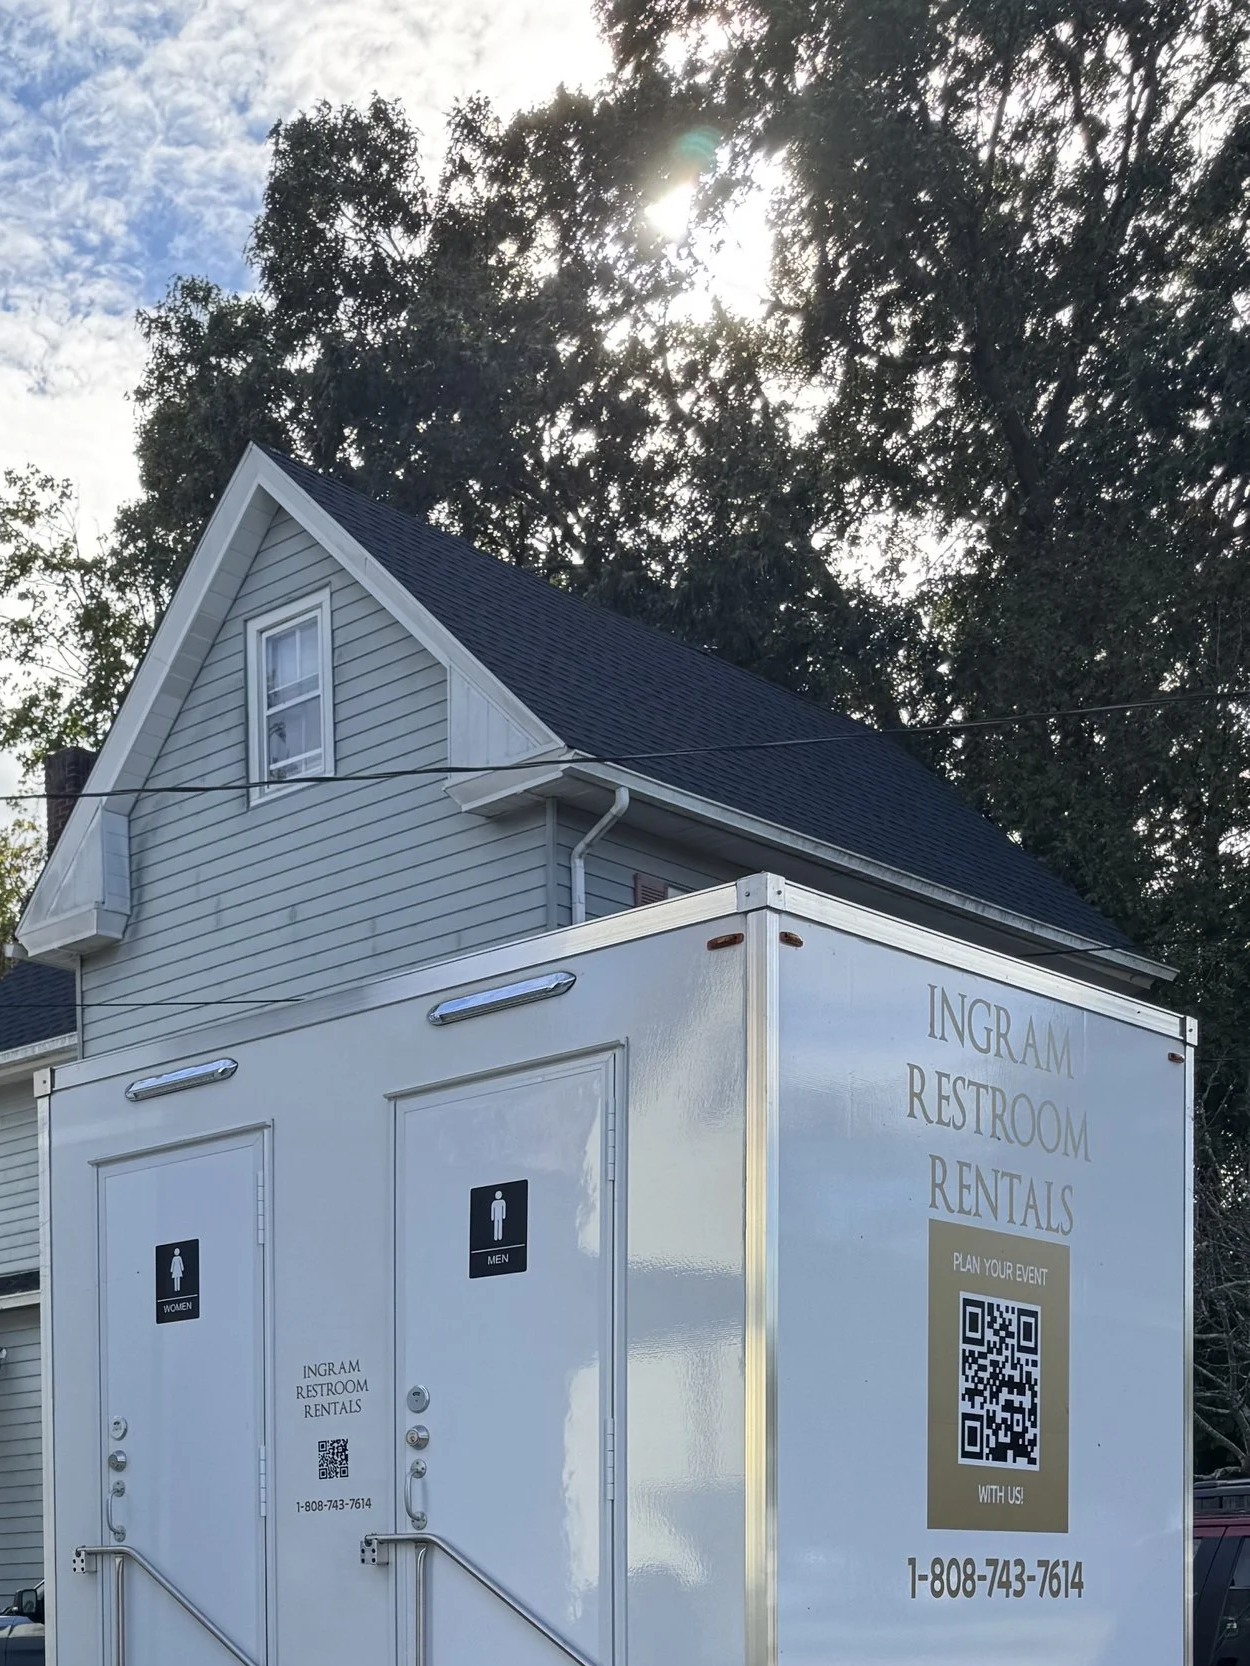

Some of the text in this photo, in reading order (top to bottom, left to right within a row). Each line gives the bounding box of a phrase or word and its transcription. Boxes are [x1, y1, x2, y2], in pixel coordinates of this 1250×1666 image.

[928, 983, 1074, 1080] INGRAM
[906, 1063, 1091, 1162] RESTROOM
[929, 1154, 1074, 1236] RENTALS
[487, 1253, 509, 1265] MEN
[953, 1252, 1048, 1286] PLAN YOUR EVENT
[163, 1301, 192, 1313] WOMEN
[303, 1359, 361, 1379] INGRAM
[296, 1378, 369, 1399] RESTROOM
[304, 1399, 362, 1418] RENTALS
[296, 1497, 372, 1513] 1-808-743-7614
[978, 1484, 1024, 1505] WITH US!
[907, 1556, 1084, 1599] 1-808-743-7614
